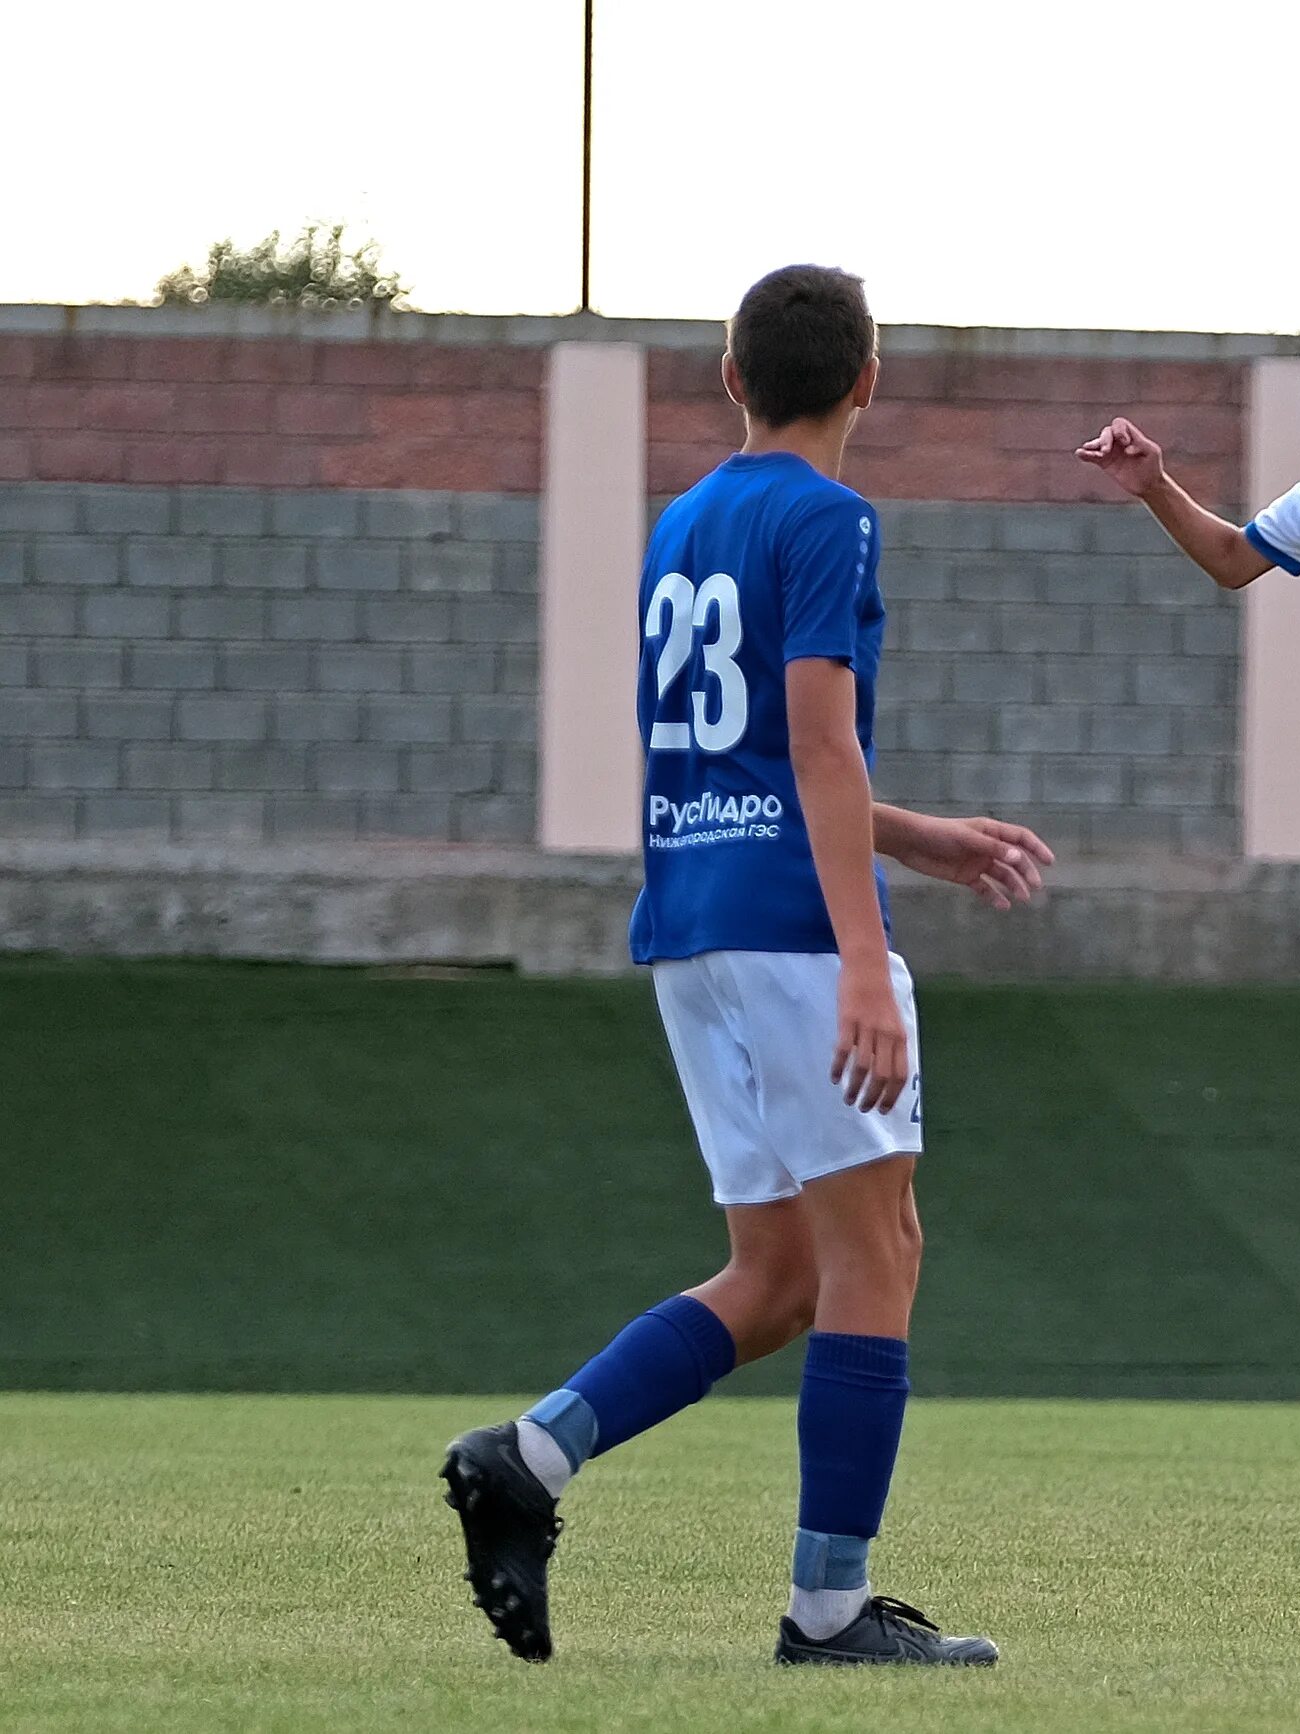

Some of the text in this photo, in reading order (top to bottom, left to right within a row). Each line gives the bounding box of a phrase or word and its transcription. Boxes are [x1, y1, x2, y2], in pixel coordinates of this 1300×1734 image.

[646, 573, 748, 751] 23
[650, 792, 782, 834] РусГидро
[649, 824, 780, 848] Нижегородская ГЭС
